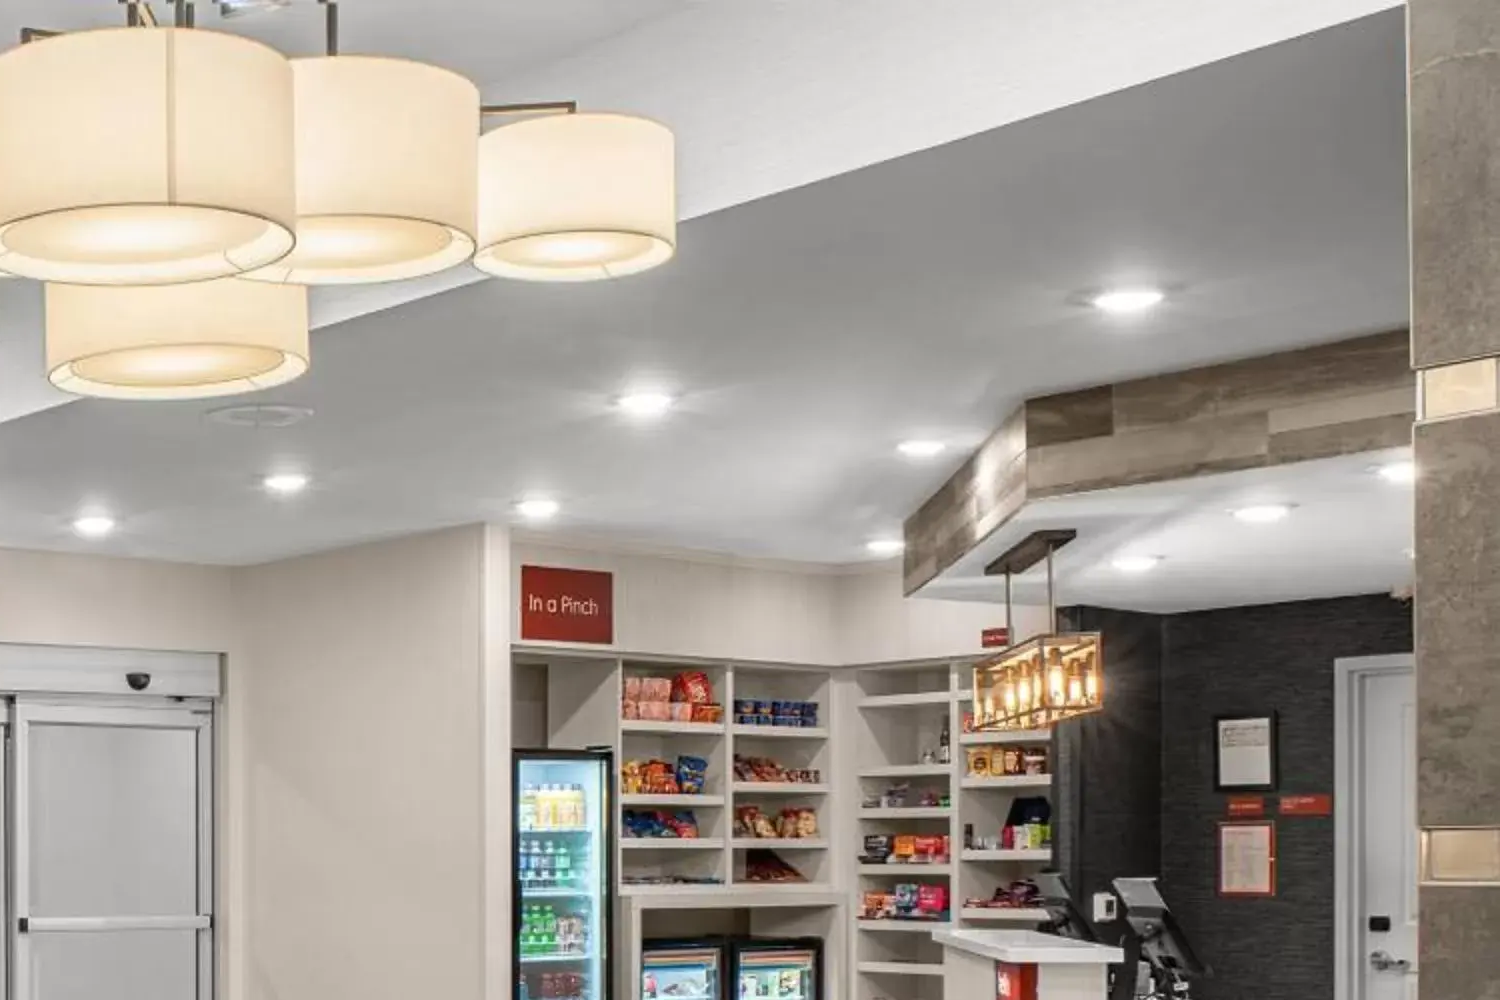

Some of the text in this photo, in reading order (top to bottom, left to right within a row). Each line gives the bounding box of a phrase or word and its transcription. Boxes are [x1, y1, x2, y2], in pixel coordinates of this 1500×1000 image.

[528, 593, 599, 616] In a Pinch
